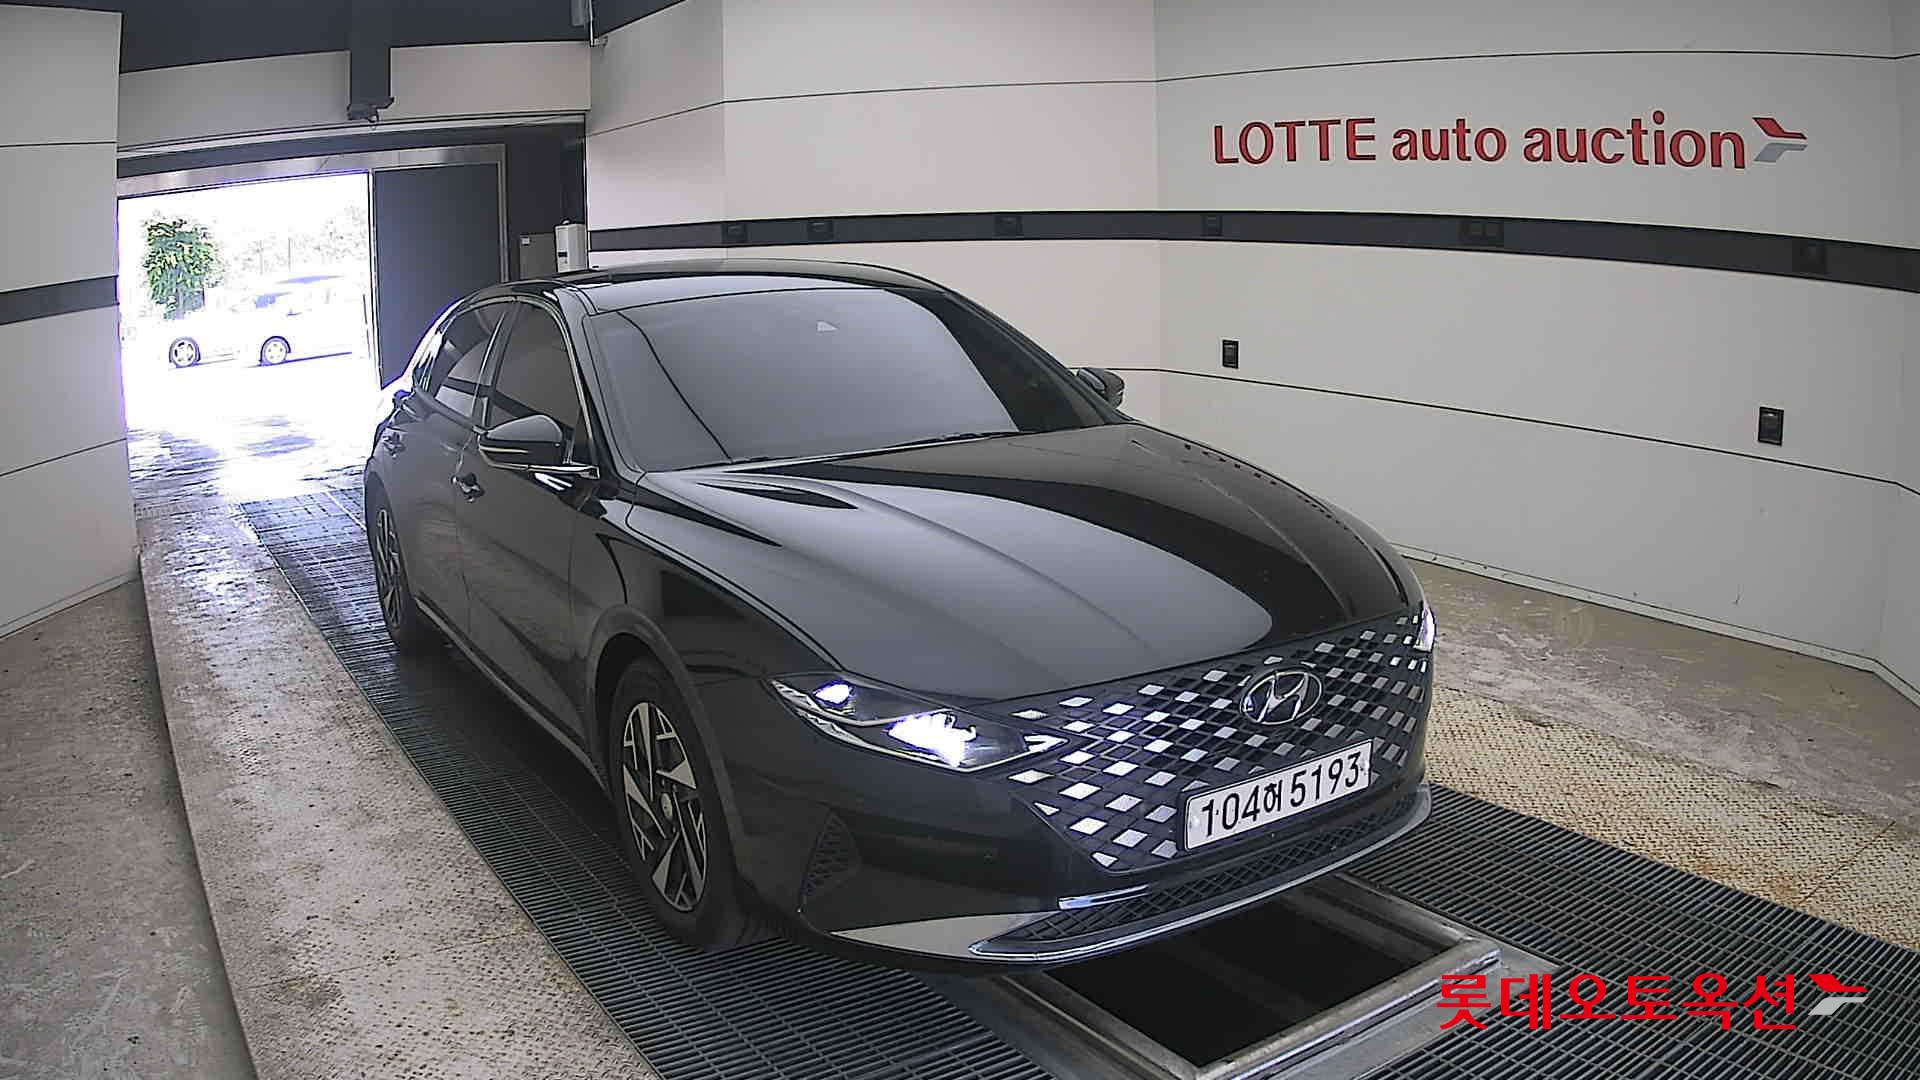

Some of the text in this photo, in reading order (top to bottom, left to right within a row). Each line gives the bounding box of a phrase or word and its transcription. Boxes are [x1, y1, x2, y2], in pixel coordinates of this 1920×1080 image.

[1214, 110, 1746, 168] LOTTE auto auction
